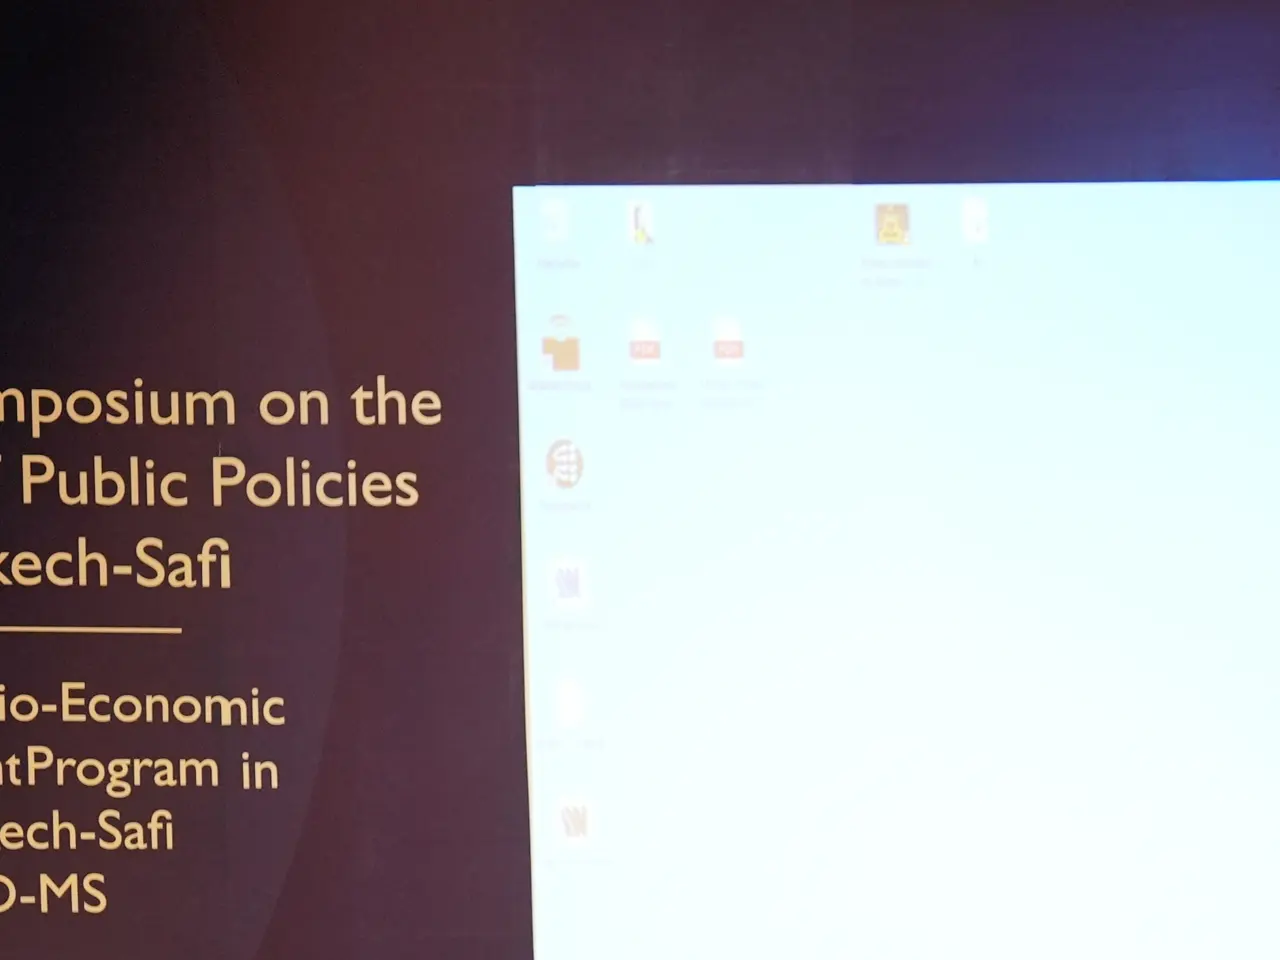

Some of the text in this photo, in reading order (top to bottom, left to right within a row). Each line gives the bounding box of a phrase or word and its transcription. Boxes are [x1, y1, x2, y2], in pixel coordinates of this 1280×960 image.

[260, 391, 328, 425] on
[351, 375, 441, 425] the
[22, 455, 419, 507] Public Policies
[242, 752, 278, 789] in
